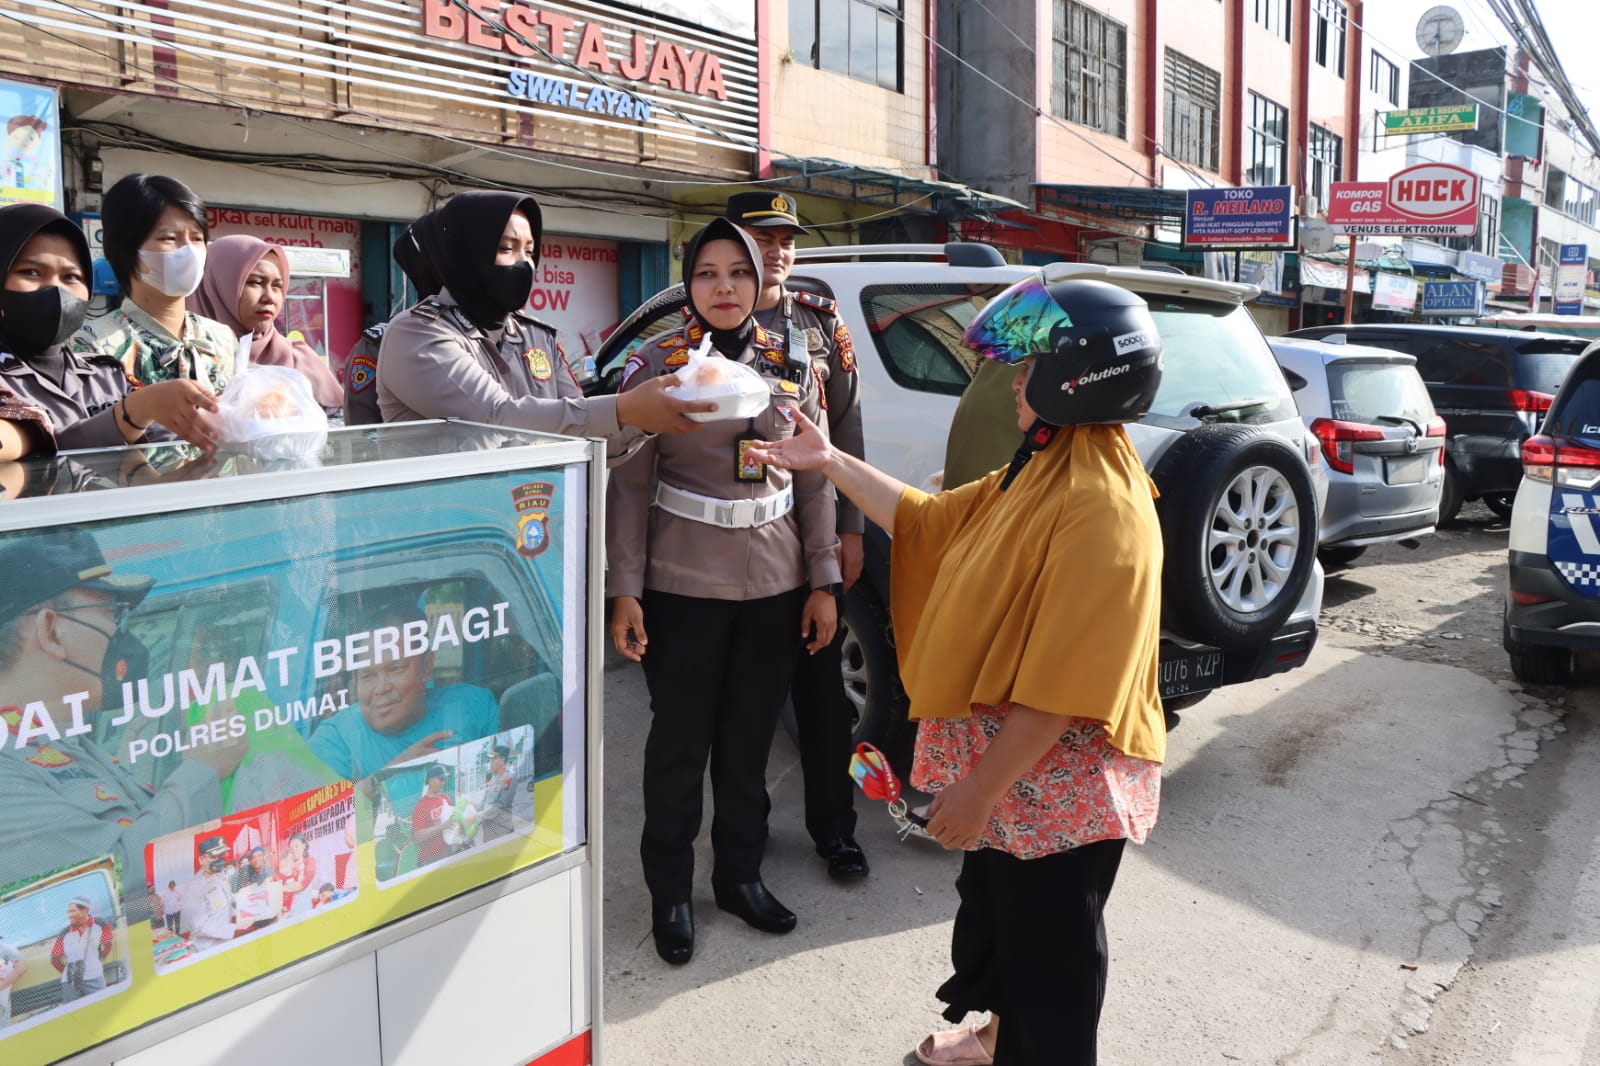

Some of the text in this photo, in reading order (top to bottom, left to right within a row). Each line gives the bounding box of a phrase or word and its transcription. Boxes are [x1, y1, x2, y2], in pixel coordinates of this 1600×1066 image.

[422, 0, 728, 100] BESTA JAYA
[507, 70, 650, 121] SWALAYAN
[1400, 114, 1461, 126] ALIFA
[1224, 190, 1253, 199] TOKO
[1336, 189, 1383, 199] KOMPOR
[1397, 179, 1467, 202] HOCK
[1193, 200, 1284, 214] R. MEILANO
[1350, 201, 1382, 213] GAS
[207, 208, 250, 229] gkat
[254, 214, 275, 227] sel
[278, 213, 314, 231] kulit
[1343, 225, 1457, 234] VENUS ELEKTRONIK
[566, 245, 618, 263] warna
[543, 264, 575, 284] bisa
[1426, 282, 1474, 297] ALAN
[522, 288, 571, 312] OW
[1425, 298, 1474, 307] OPTICAL
[1060, 363, 1131, 391] evolution
[519, 500, 546, 509] RIAU
[110, 647, 300, 727] JUMAT
[312, 601, 510, 679] BERBAGI
[1196, 653, 1220, 678] KZP
[128, 688, 350, 765] POLRES DUMAI
